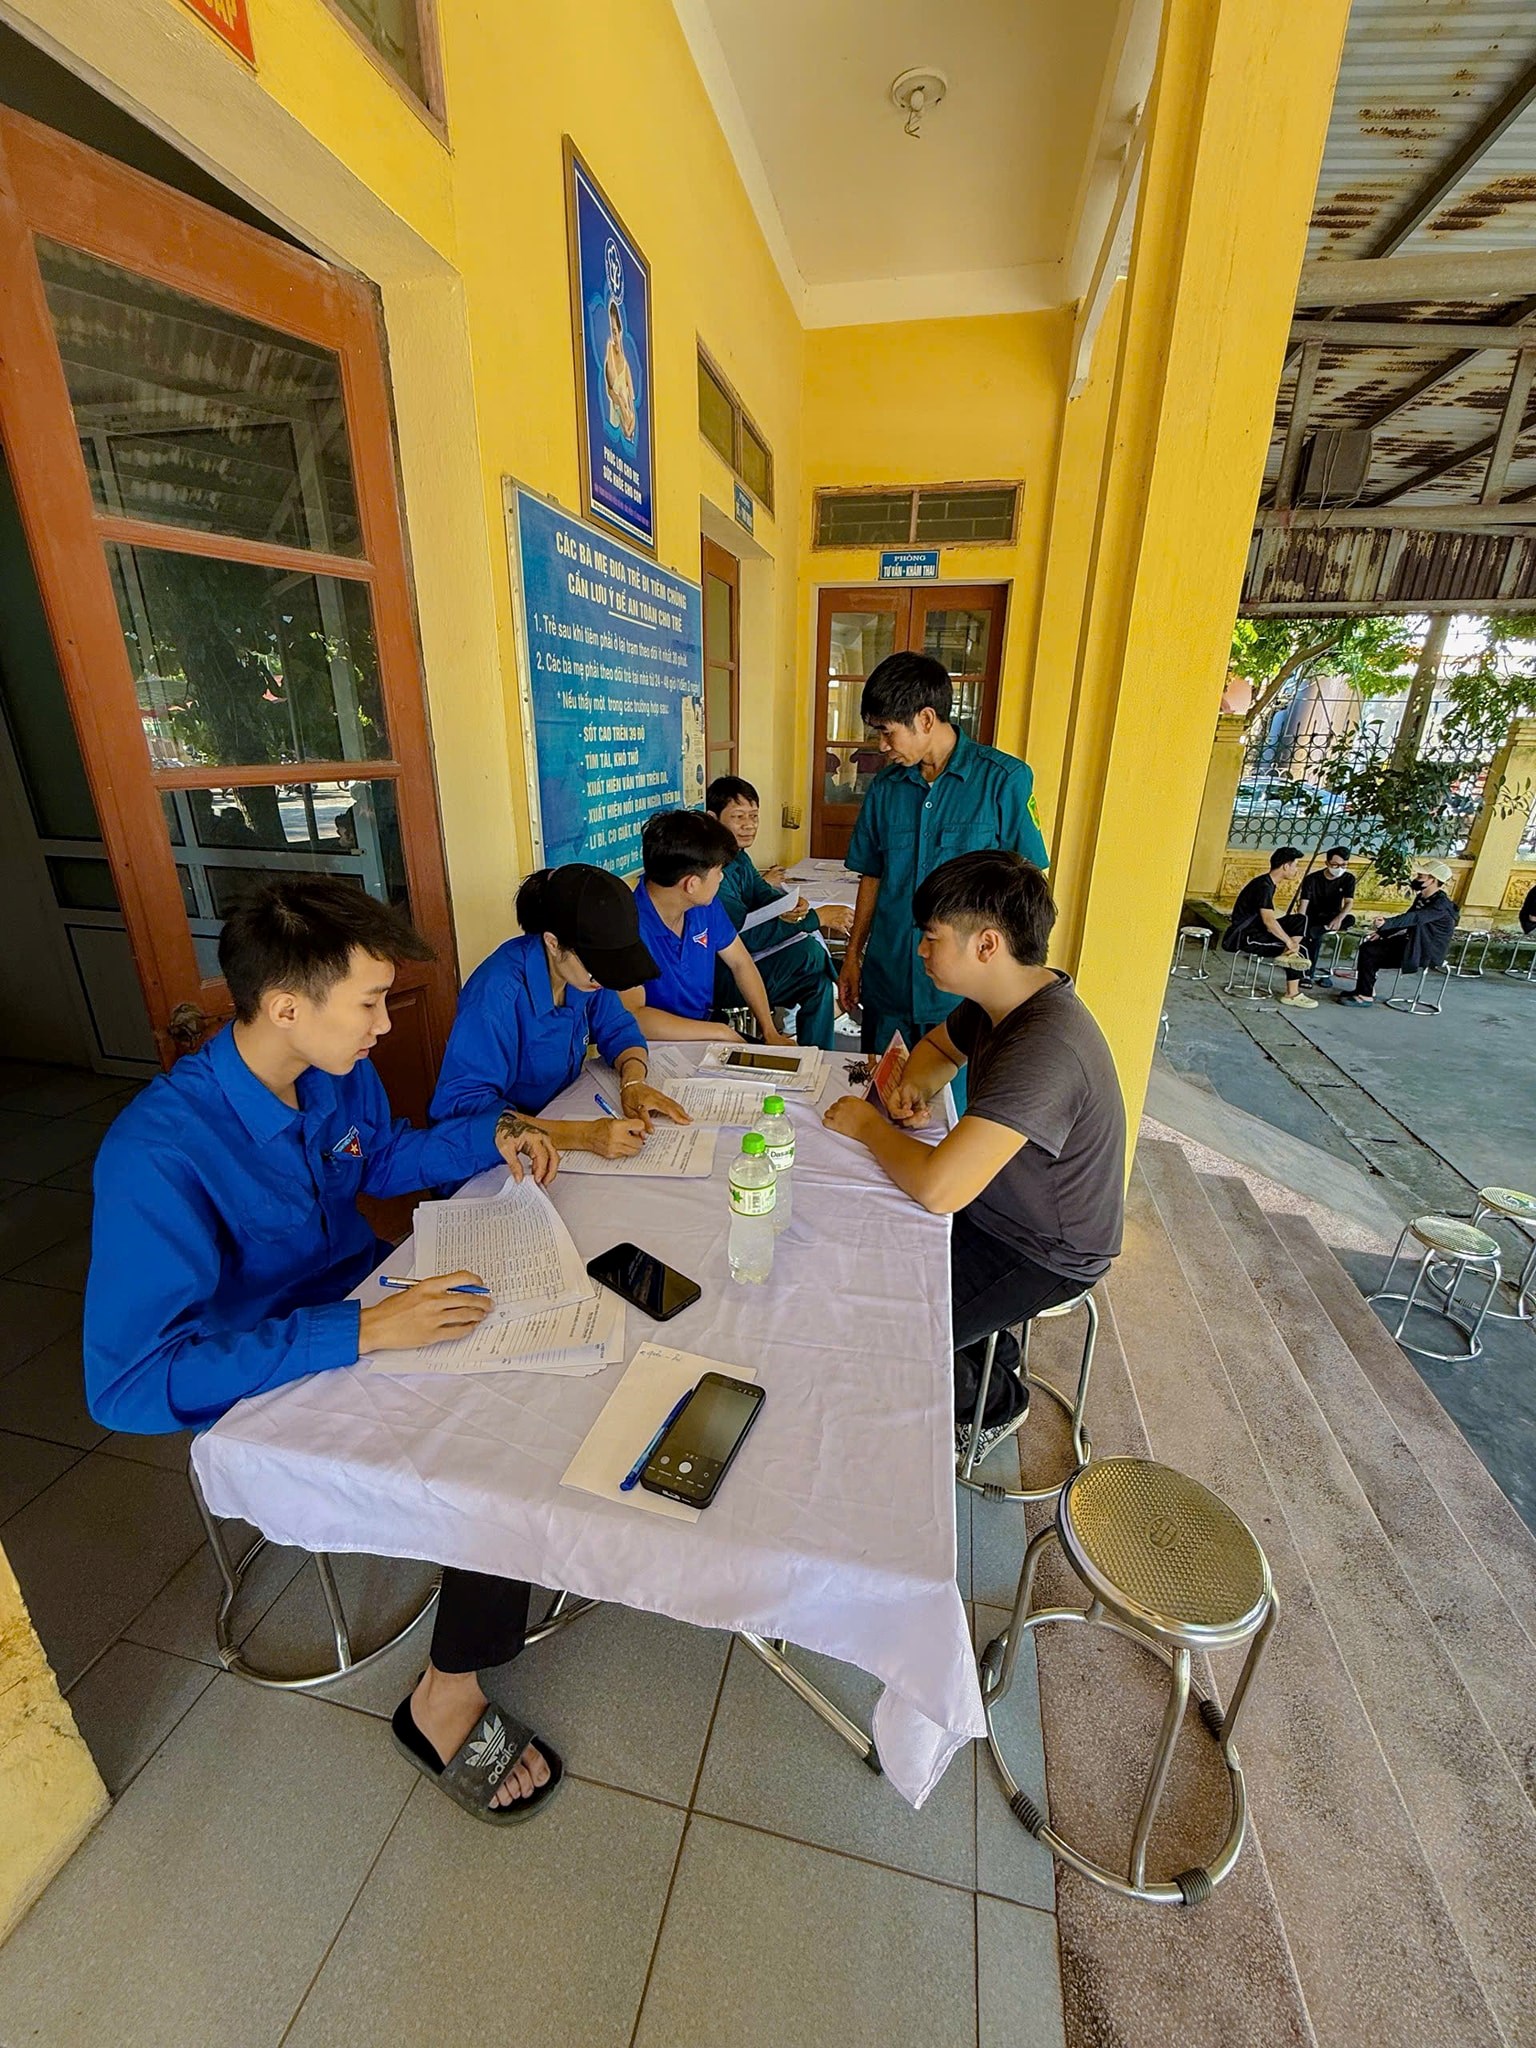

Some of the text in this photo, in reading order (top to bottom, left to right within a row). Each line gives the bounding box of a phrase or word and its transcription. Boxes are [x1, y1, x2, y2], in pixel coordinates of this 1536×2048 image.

[556, 531, 687, 610] CÁC BÀ MẸ ĐƯA TRẺ ĐI TIÊM CHỦNG
[894, 554, 926, 562] PHÒNG
[906, 563, 922, 577] KHÁM
[923, 564, 936, 577] THAI
[590, 582, 607, 606] LƯU
[608, 588, 614, 608] Ý
[616, 588, 626, 613] ĐỂ
[628, 598, 639, 618] AN
[640, 602, 658, 622] TOÀN
[658, 610, 671, 629] CHO
[672, 611, 682, 633] TRẺ
[534, 612, 542, 632] 1.
[543, 614, 557, 635] Trẻ
[558, 624, 571, 638] sau
[573, 624, 584, 642] khi
[585, 627, 599, 646] tiêm
[626, 638, 638, 658] trạm
[639, 642, 650, 658] theo
[536, 652, 544, 671] 2.
[546, 653, 561, 672] Các
[562, 656, 573, 674] bà
[574, 664, 584, 681] mẹ
[585, 660, 599, 682] phải
[600, 662, 613, 680] theo
[562, 689, 578, 710] Nếu
[578, 690, 592, 714] thấy
[594, 695, 606, 714] một
[624, 697, 634, 712] các
[583, 721, 598, 742] SỐT
[598, 726, 612, 742] CAO
[612, 724, 628, 742] TRÊN
[629, 726, 636, 742] 39
[585, 752, 599, 770] TÍM
[614, 749, 626, 767] KHÓ
[628, 747, 639, 766] THỞ
[587, 775, 604, 797] XUẤT
[606, 775, 622, 796] HIỆN
[646, 770, 660, 786] TRÊN
[588, 801, 606, 824] XUẤT
[607, 801, 622, 820] HIỆN
[662, 790, 674, 806] TRÊN
[590, 835, 596, 850] LI
[608, 828, 617, 844] CO
[616, 853, 630, 870] ngay
[631, 846, 639, 862] trẻ
